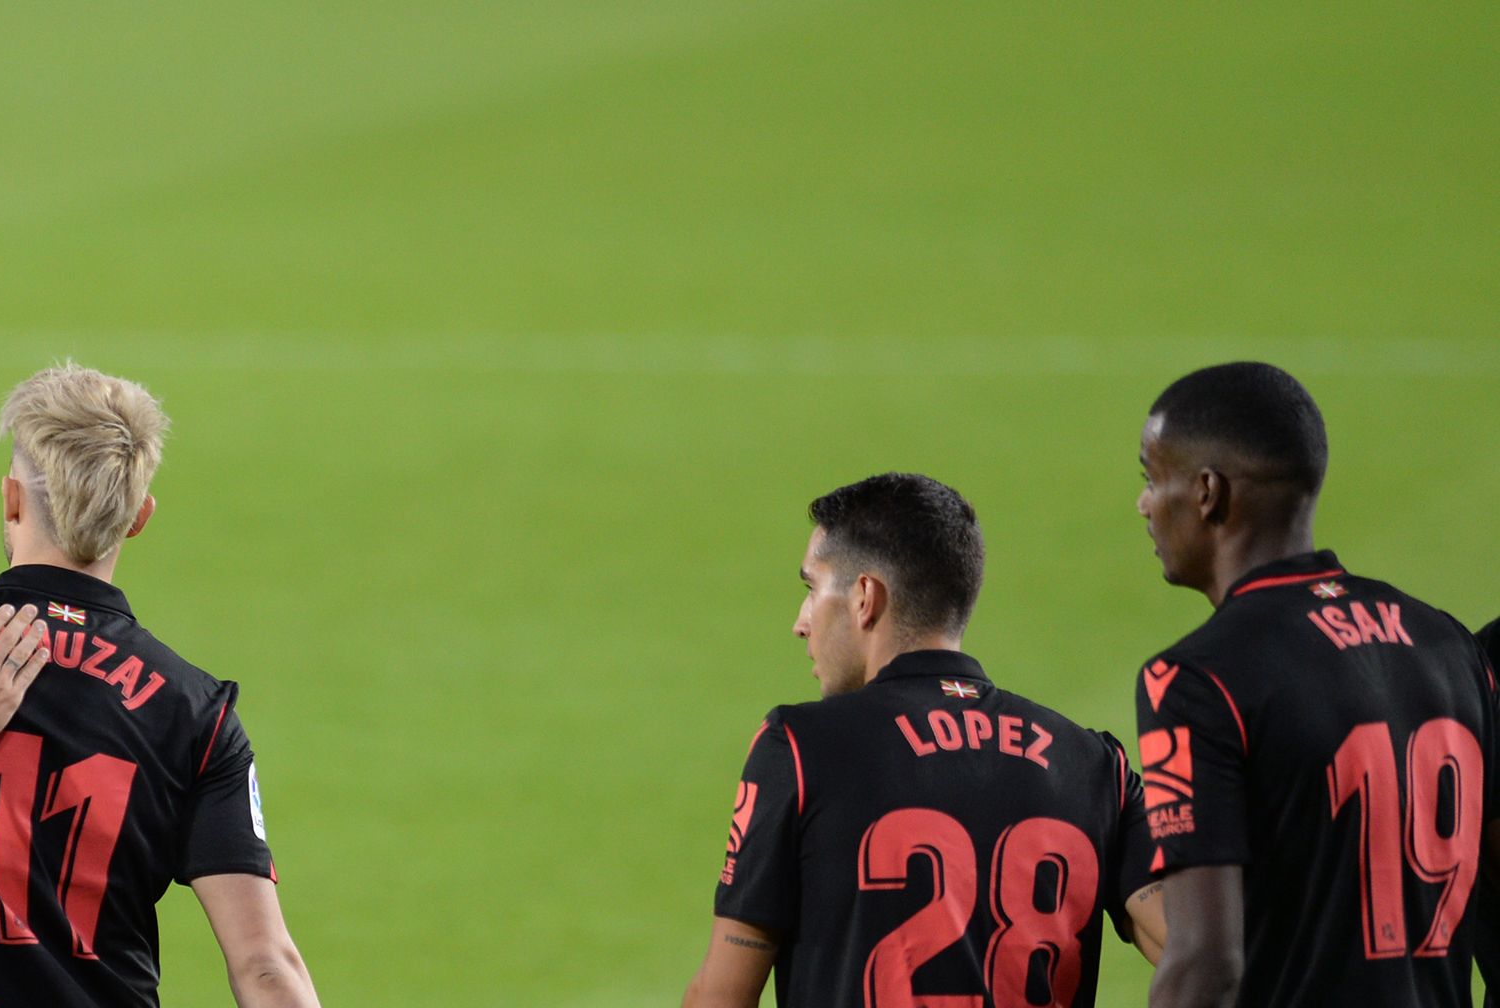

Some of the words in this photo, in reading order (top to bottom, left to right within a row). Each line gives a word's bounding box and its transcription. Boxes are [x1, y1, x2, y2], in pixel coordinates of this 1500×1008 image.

[1308, 602, 1413, 650] ISAK
[895, 710, 1053, 769] LOPEZ
[1327, 717, 1483, 960] 19
